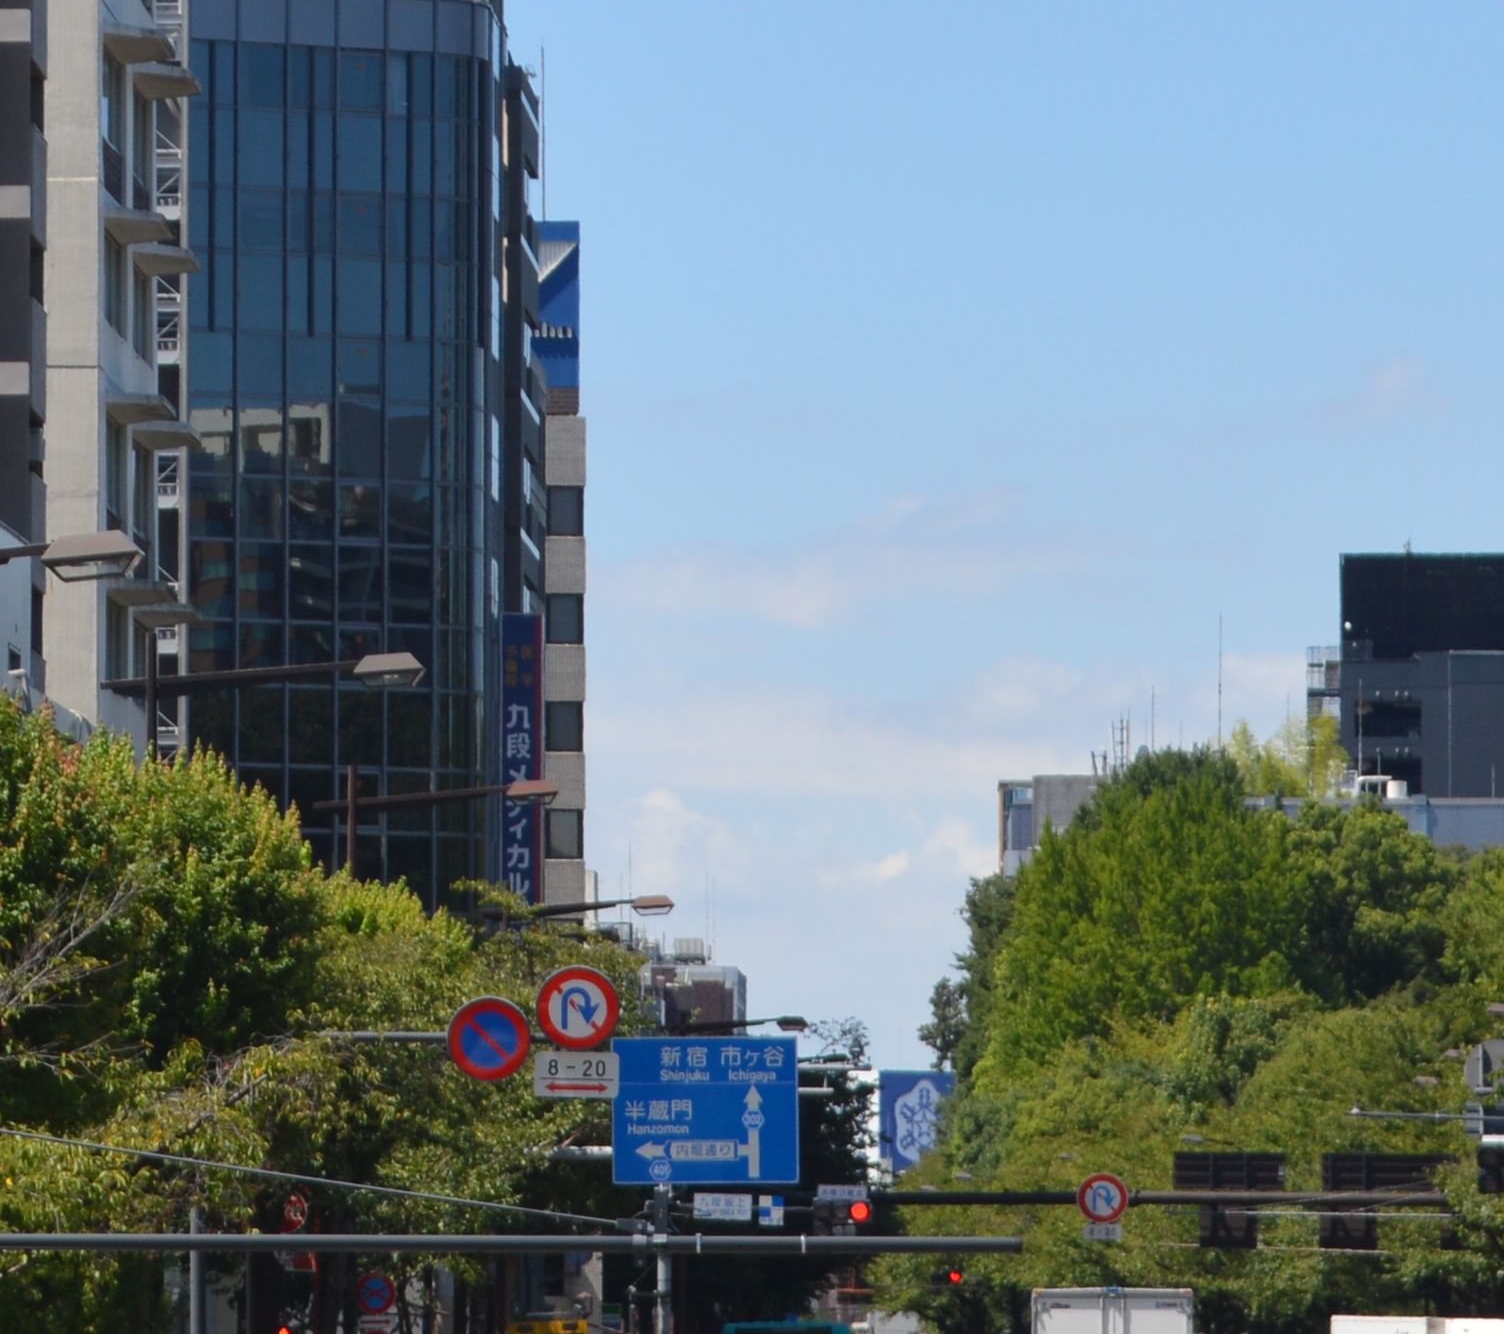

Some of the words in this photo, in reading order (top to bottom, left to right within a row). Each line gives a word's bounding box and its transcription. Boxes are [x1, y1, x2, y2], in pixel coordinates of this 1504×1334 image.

[660, 1046, 708, 1067] 新宿
[660, 1069, 710, 1083] Shinjuku
[729, 1069, 777, 1083] Ichigaya
[625, 1099, 692, 1120] 半蔵門
[627, 1123, 689, 1135] Hanzomon
[676, 1143, 731, 1158] 内堀通り
